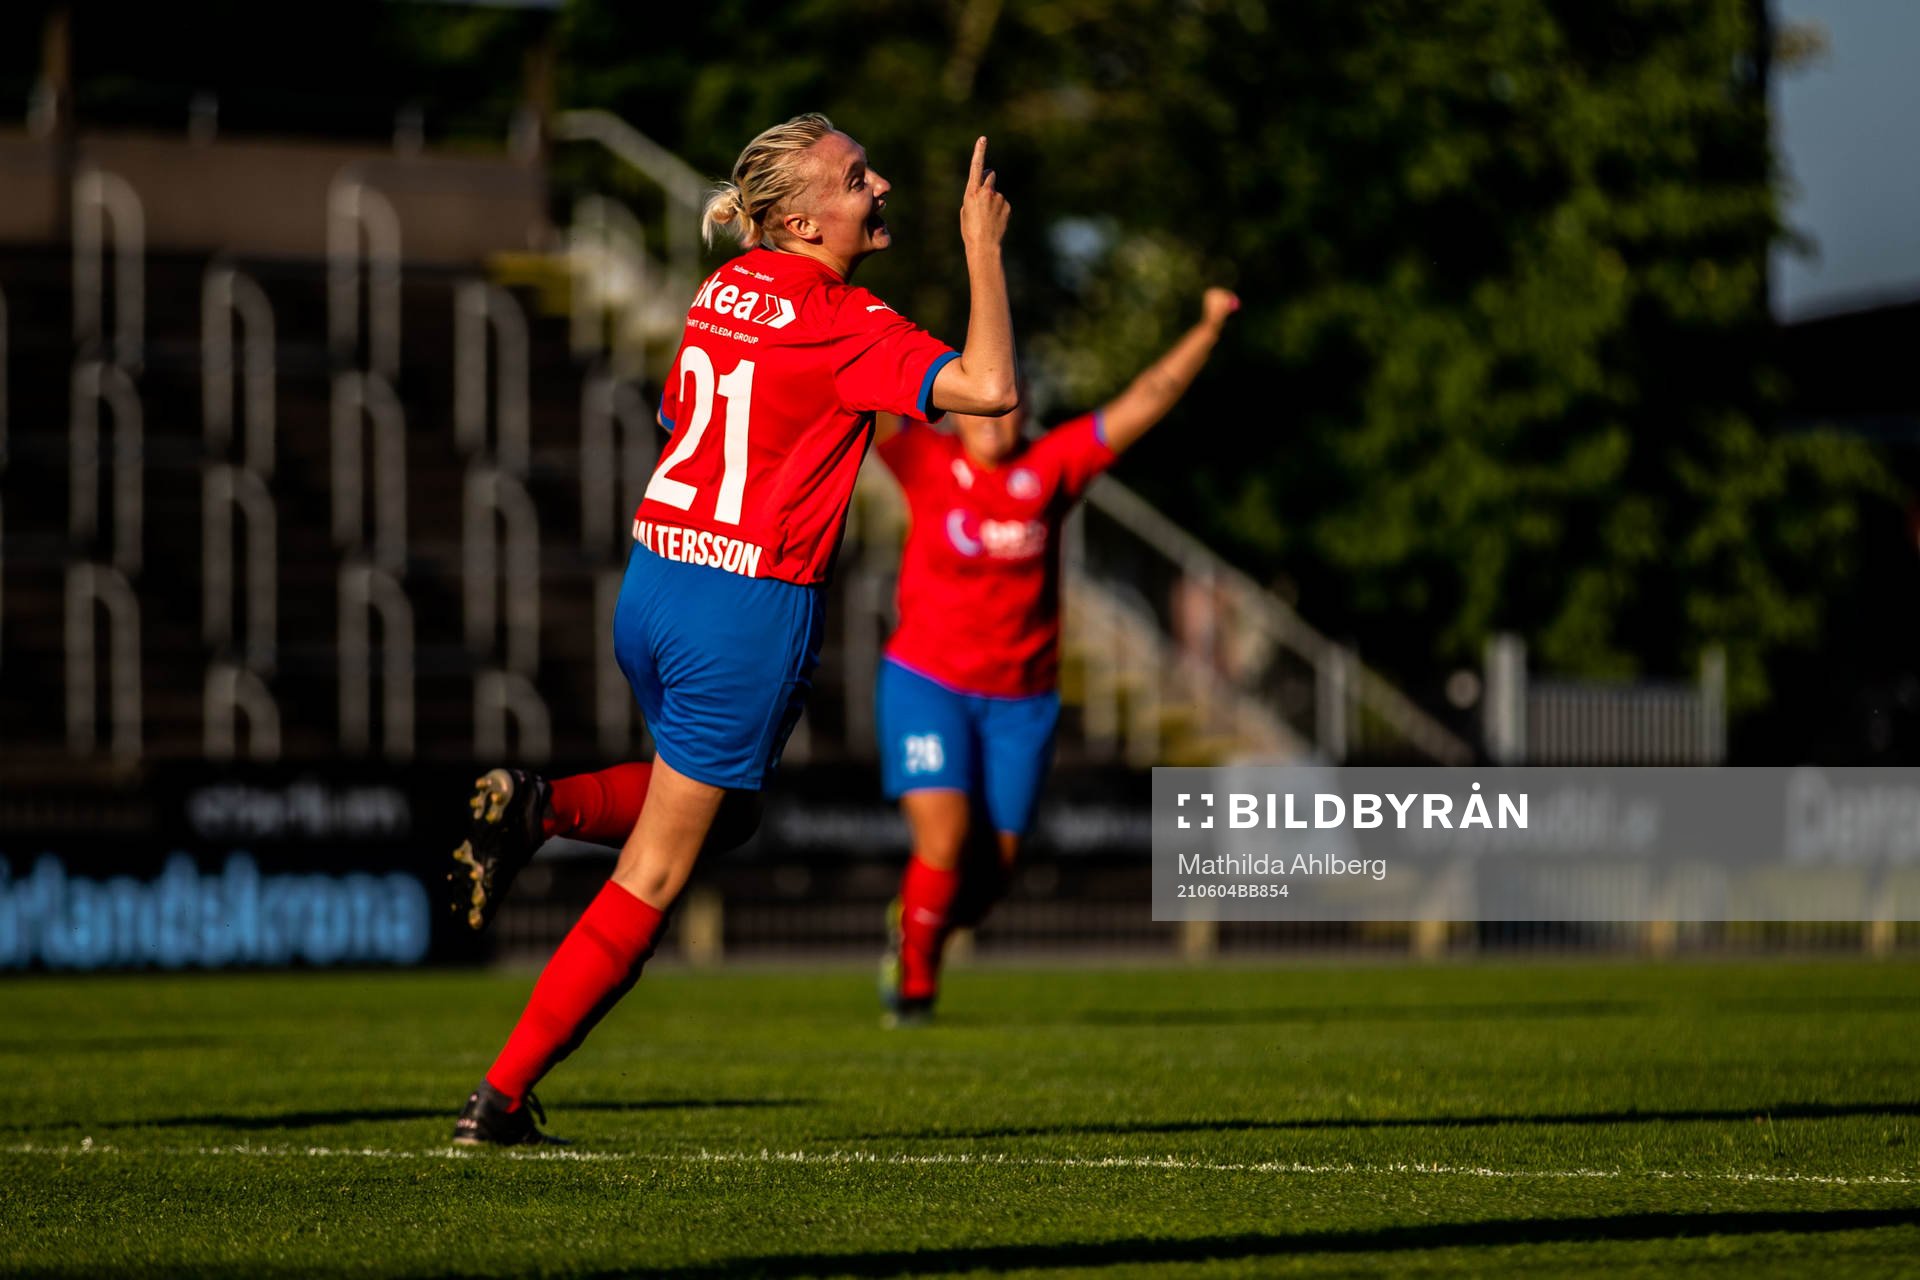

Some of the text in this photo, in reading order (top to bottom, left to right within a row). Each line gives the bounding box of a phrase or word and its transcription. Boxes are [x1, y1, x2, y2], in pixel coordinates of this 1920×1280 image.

[687, 317, 759, 345] ART OF ELEDA GROUP
[644, 345, 755, 526] 21
